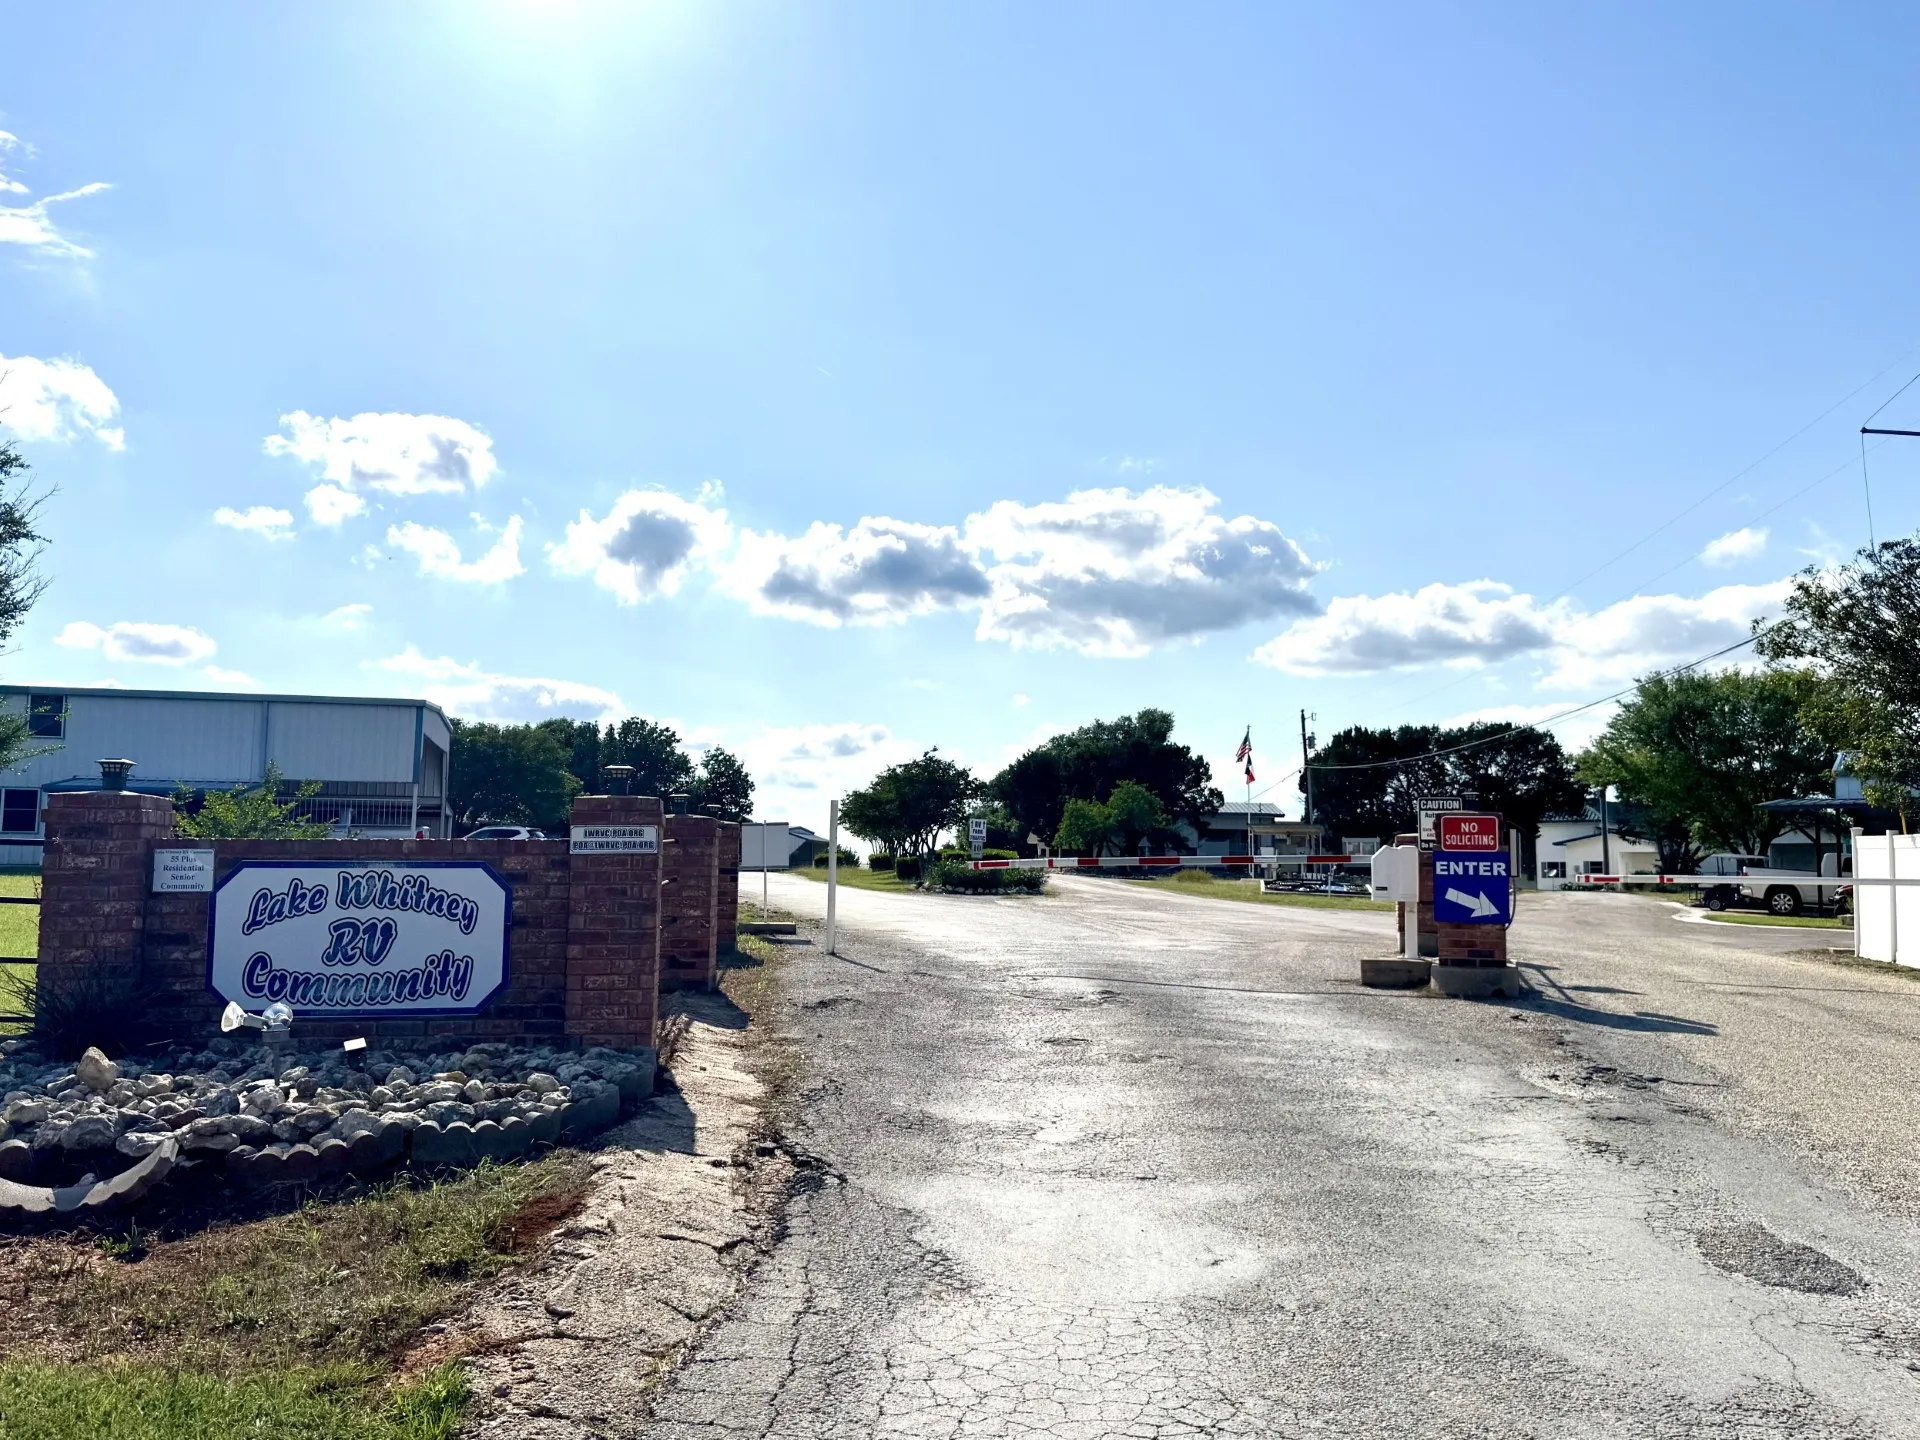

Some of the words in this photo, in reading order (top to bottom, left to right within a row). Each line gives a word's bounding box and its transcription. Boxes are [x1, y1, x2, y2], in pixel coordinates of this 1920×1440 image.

[1420, 800, 1460, 809] CAUTION
[1460, 822, 1478, 833] NO
[1445, 834, 1494, 846] SOLICITING
[1435, 861, 1507, 876] ENTER
[161, 882, 204, 890] Community
[242, 878, 328, 935] Lake
[336, 870, 478, 934] Whitney
[322, 917, 398, 966] RV
[242, 950, 473, 1006] Community
